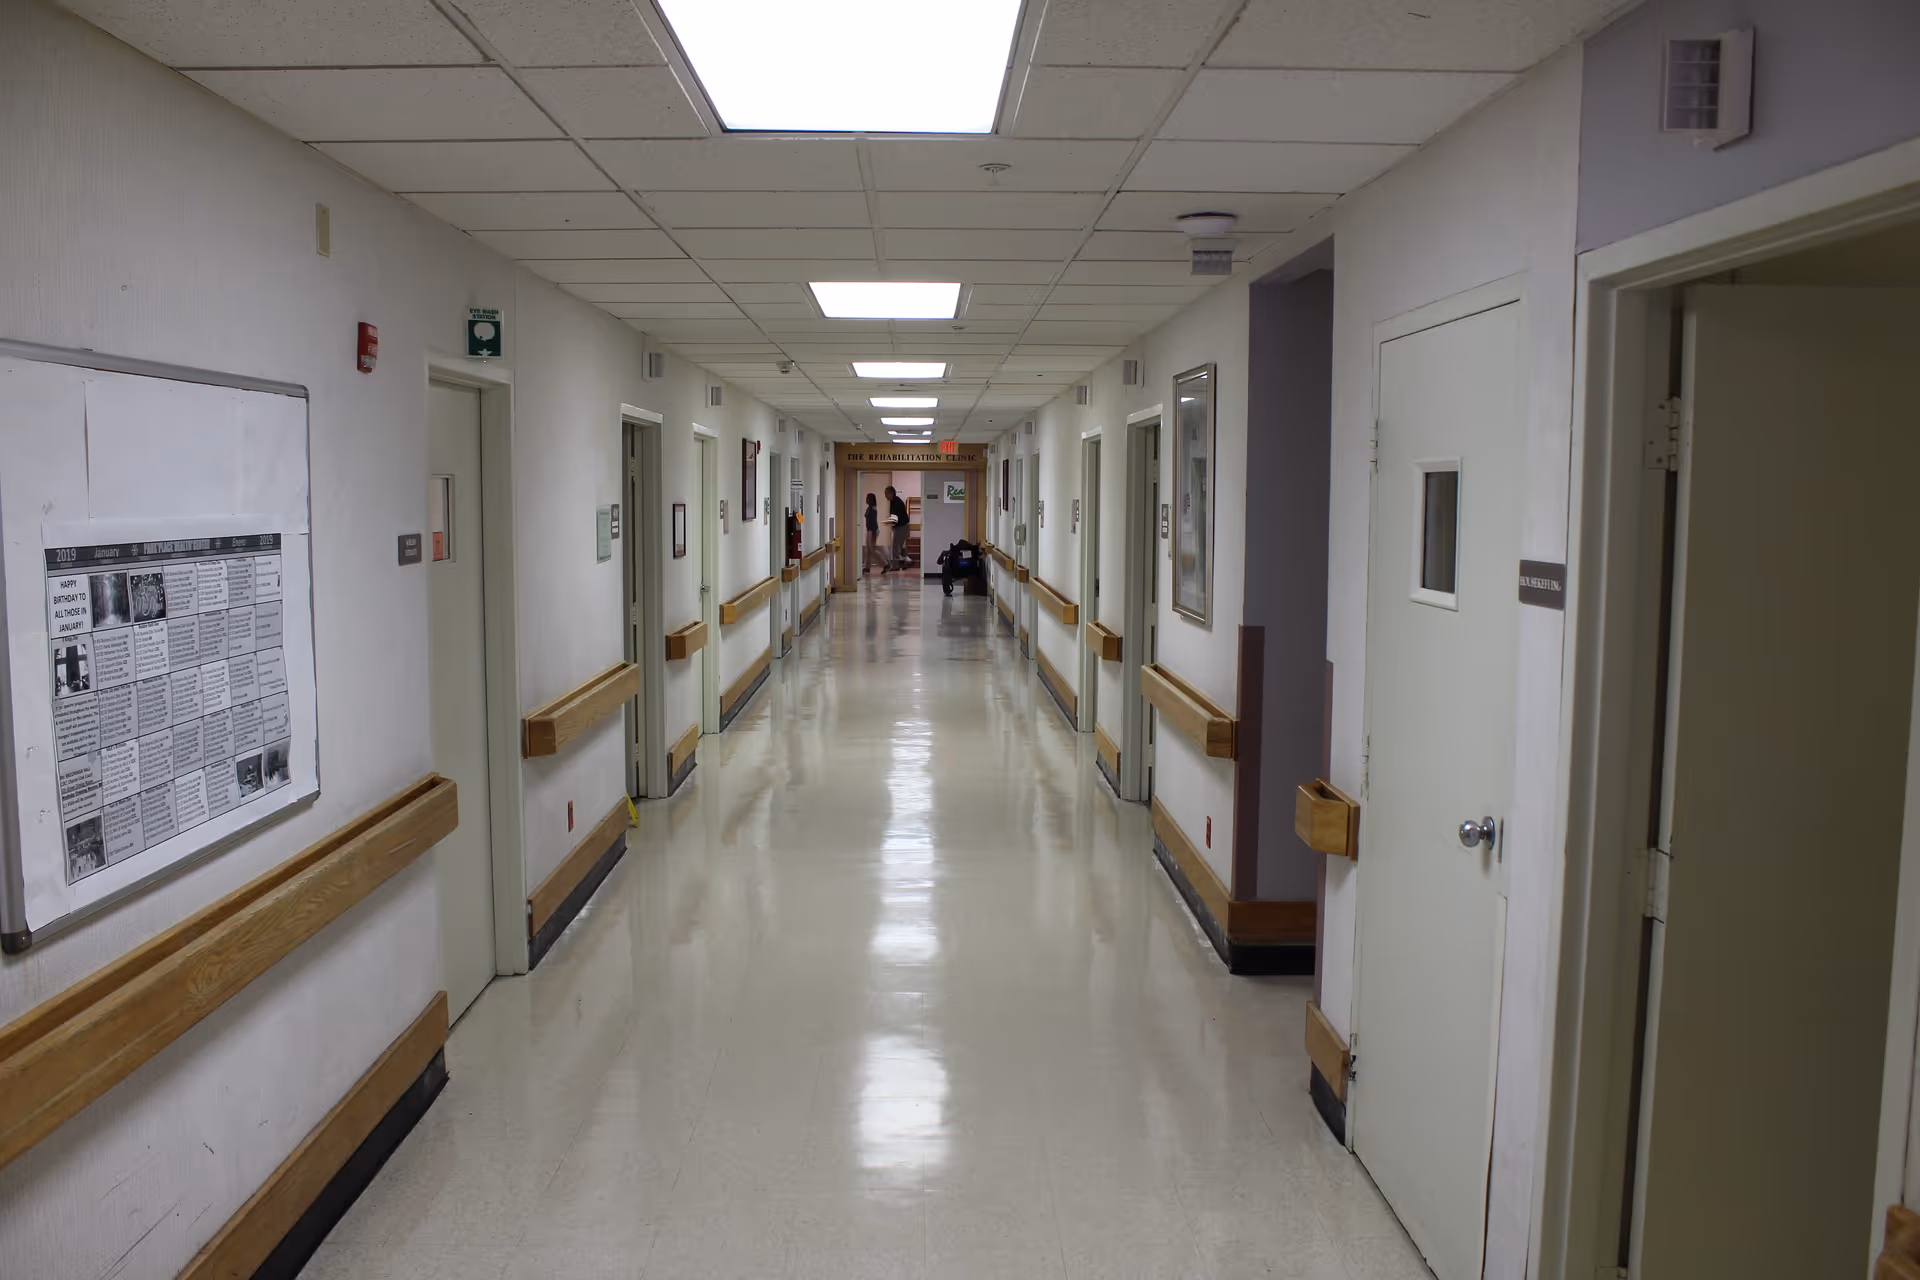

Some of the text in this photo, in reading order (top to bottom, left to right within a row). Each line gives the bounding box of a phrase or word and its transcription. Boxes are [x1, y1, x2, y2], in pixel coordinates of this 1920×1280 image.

[941, 440, 957, 453] EXIT
[848, 453, 977, 462] THE REHABILITATION CLINIC
[56, 547, 77, 562] 2019
[94, 546, 120, 559] January
[260, 534, 274, 546] 2019
[60, 579, 78, 589] HAPPY
[53, 592, 86, 604] BIRTHDAY TO
[55, 607, 87, 619] ALL THOSE IN
[58, 620, 84, 632] JANUARY!
